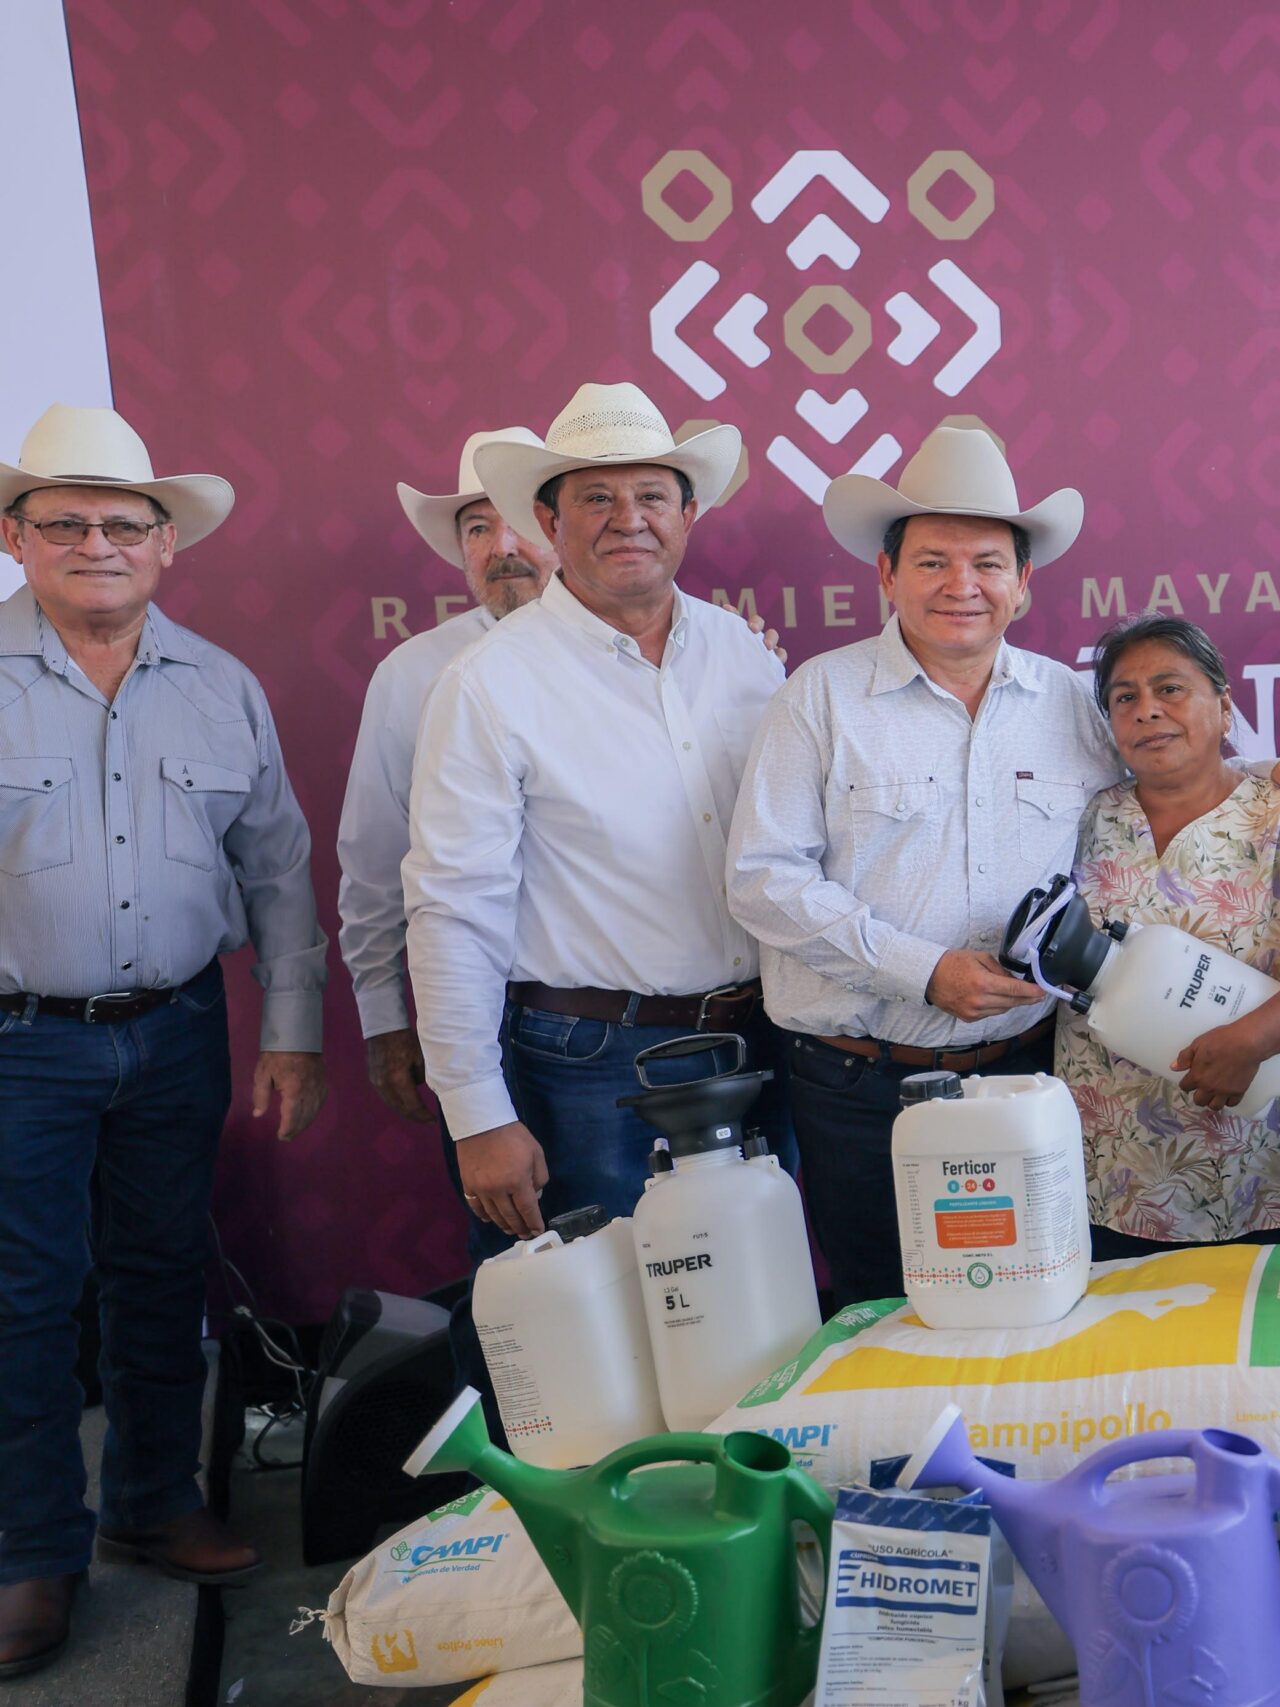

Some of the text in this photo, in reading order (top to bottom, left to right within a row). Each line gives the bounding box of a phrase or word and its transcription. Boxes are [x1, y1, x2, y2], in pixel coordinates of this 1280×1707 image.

[1180, 954, 1212, 1009] TRUPER
[1214, 984, 1232, 1006] 5 L
[942, 1160, 996, 1176] Ferticor
[645, 1253, 713, 1278] TRUPER
[666, 1294, 690, 1310] 5 L
[757, 1424, 831, 1449] MPI
[966, 1402, 1172, 1455] ampipollo
[411, 1534, 504, 1566] CAMPI
[451, 1563, 480, 1573] Verdad
[860, 1572, 977, 1599] HIDROMET
[956, 1698, 970, 1707] kg
